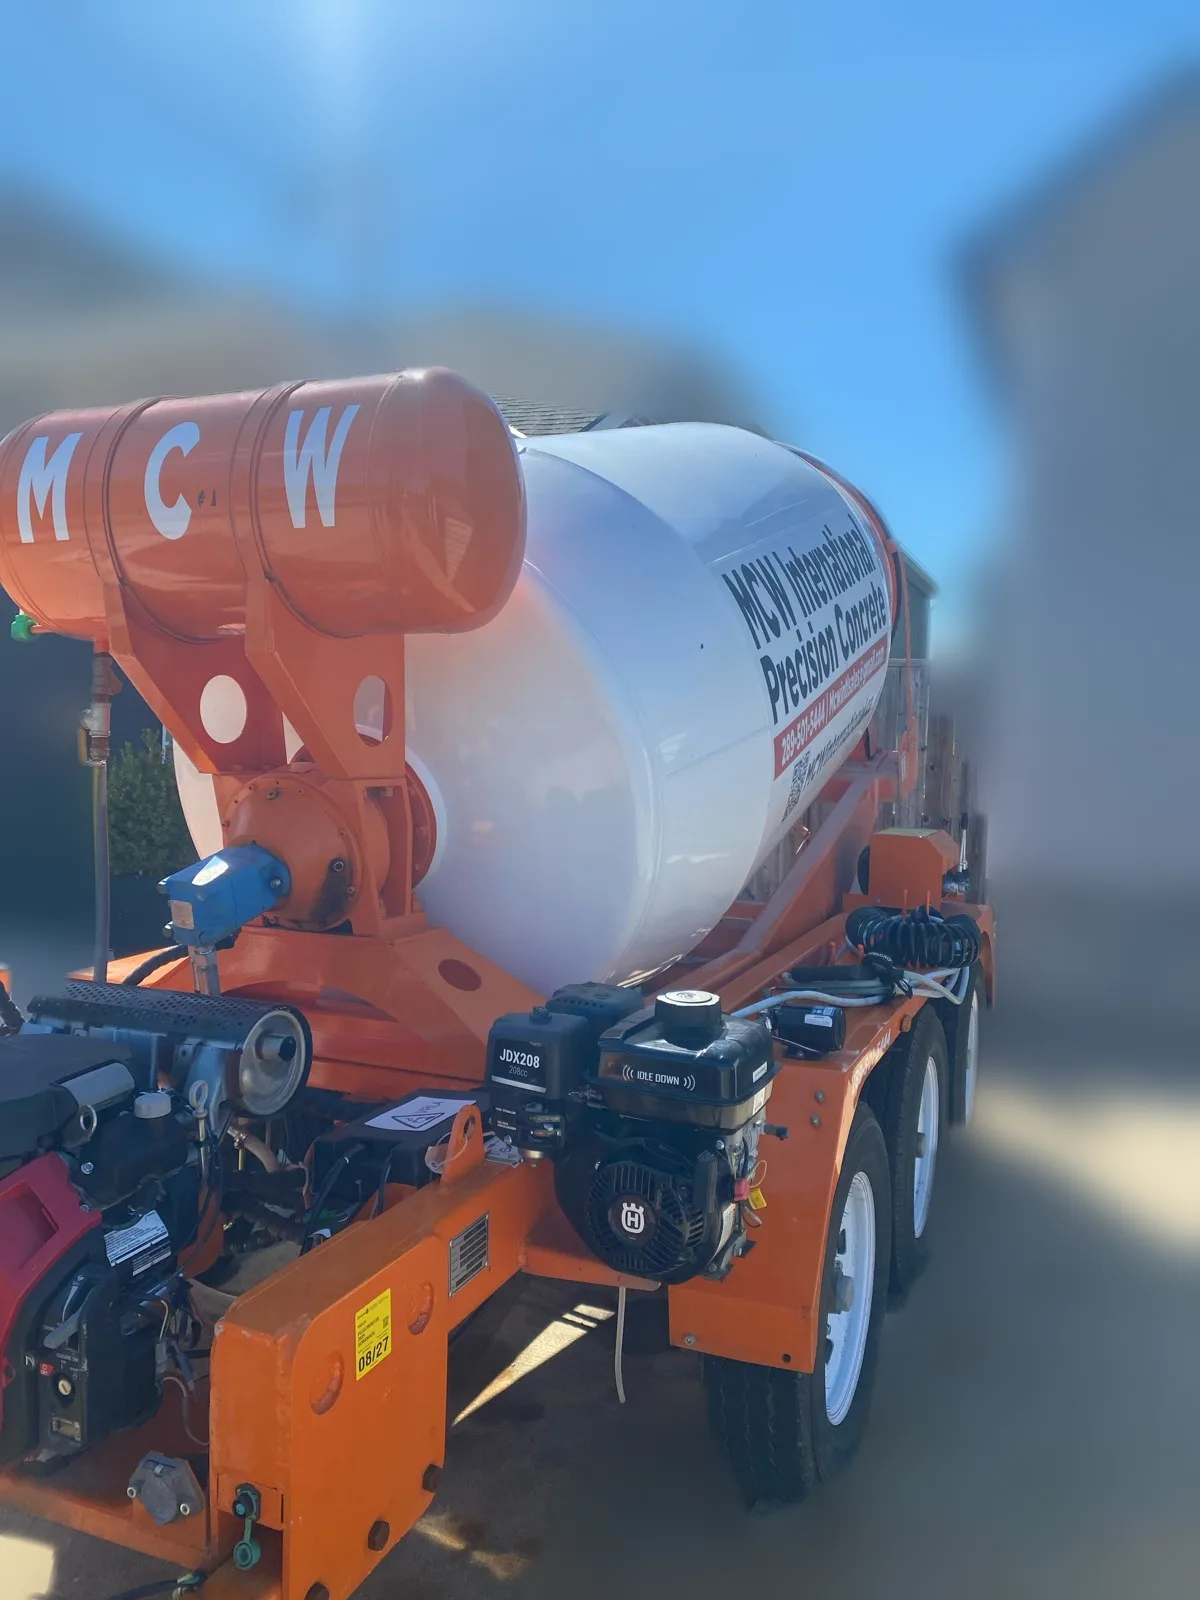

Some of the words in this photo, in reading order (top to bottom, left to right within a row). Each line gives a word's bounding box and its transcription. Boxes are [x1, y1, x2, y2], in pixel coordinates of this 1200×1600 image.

[721, 555, 798, 650] MCW
[771, 513, 876, 618] International
[759, 621, 839, 725] Precision
[834, 581, 887, 661] Concrete
[499, 1048, 540, 1069] JDX208
[509, 1065, 528, 1078] 208cc
[637, 1071, 653, 1082] IDLE
[655, 1073, 680, 1086] DOWN
[358, 1335, 389, 1373] 08/27
